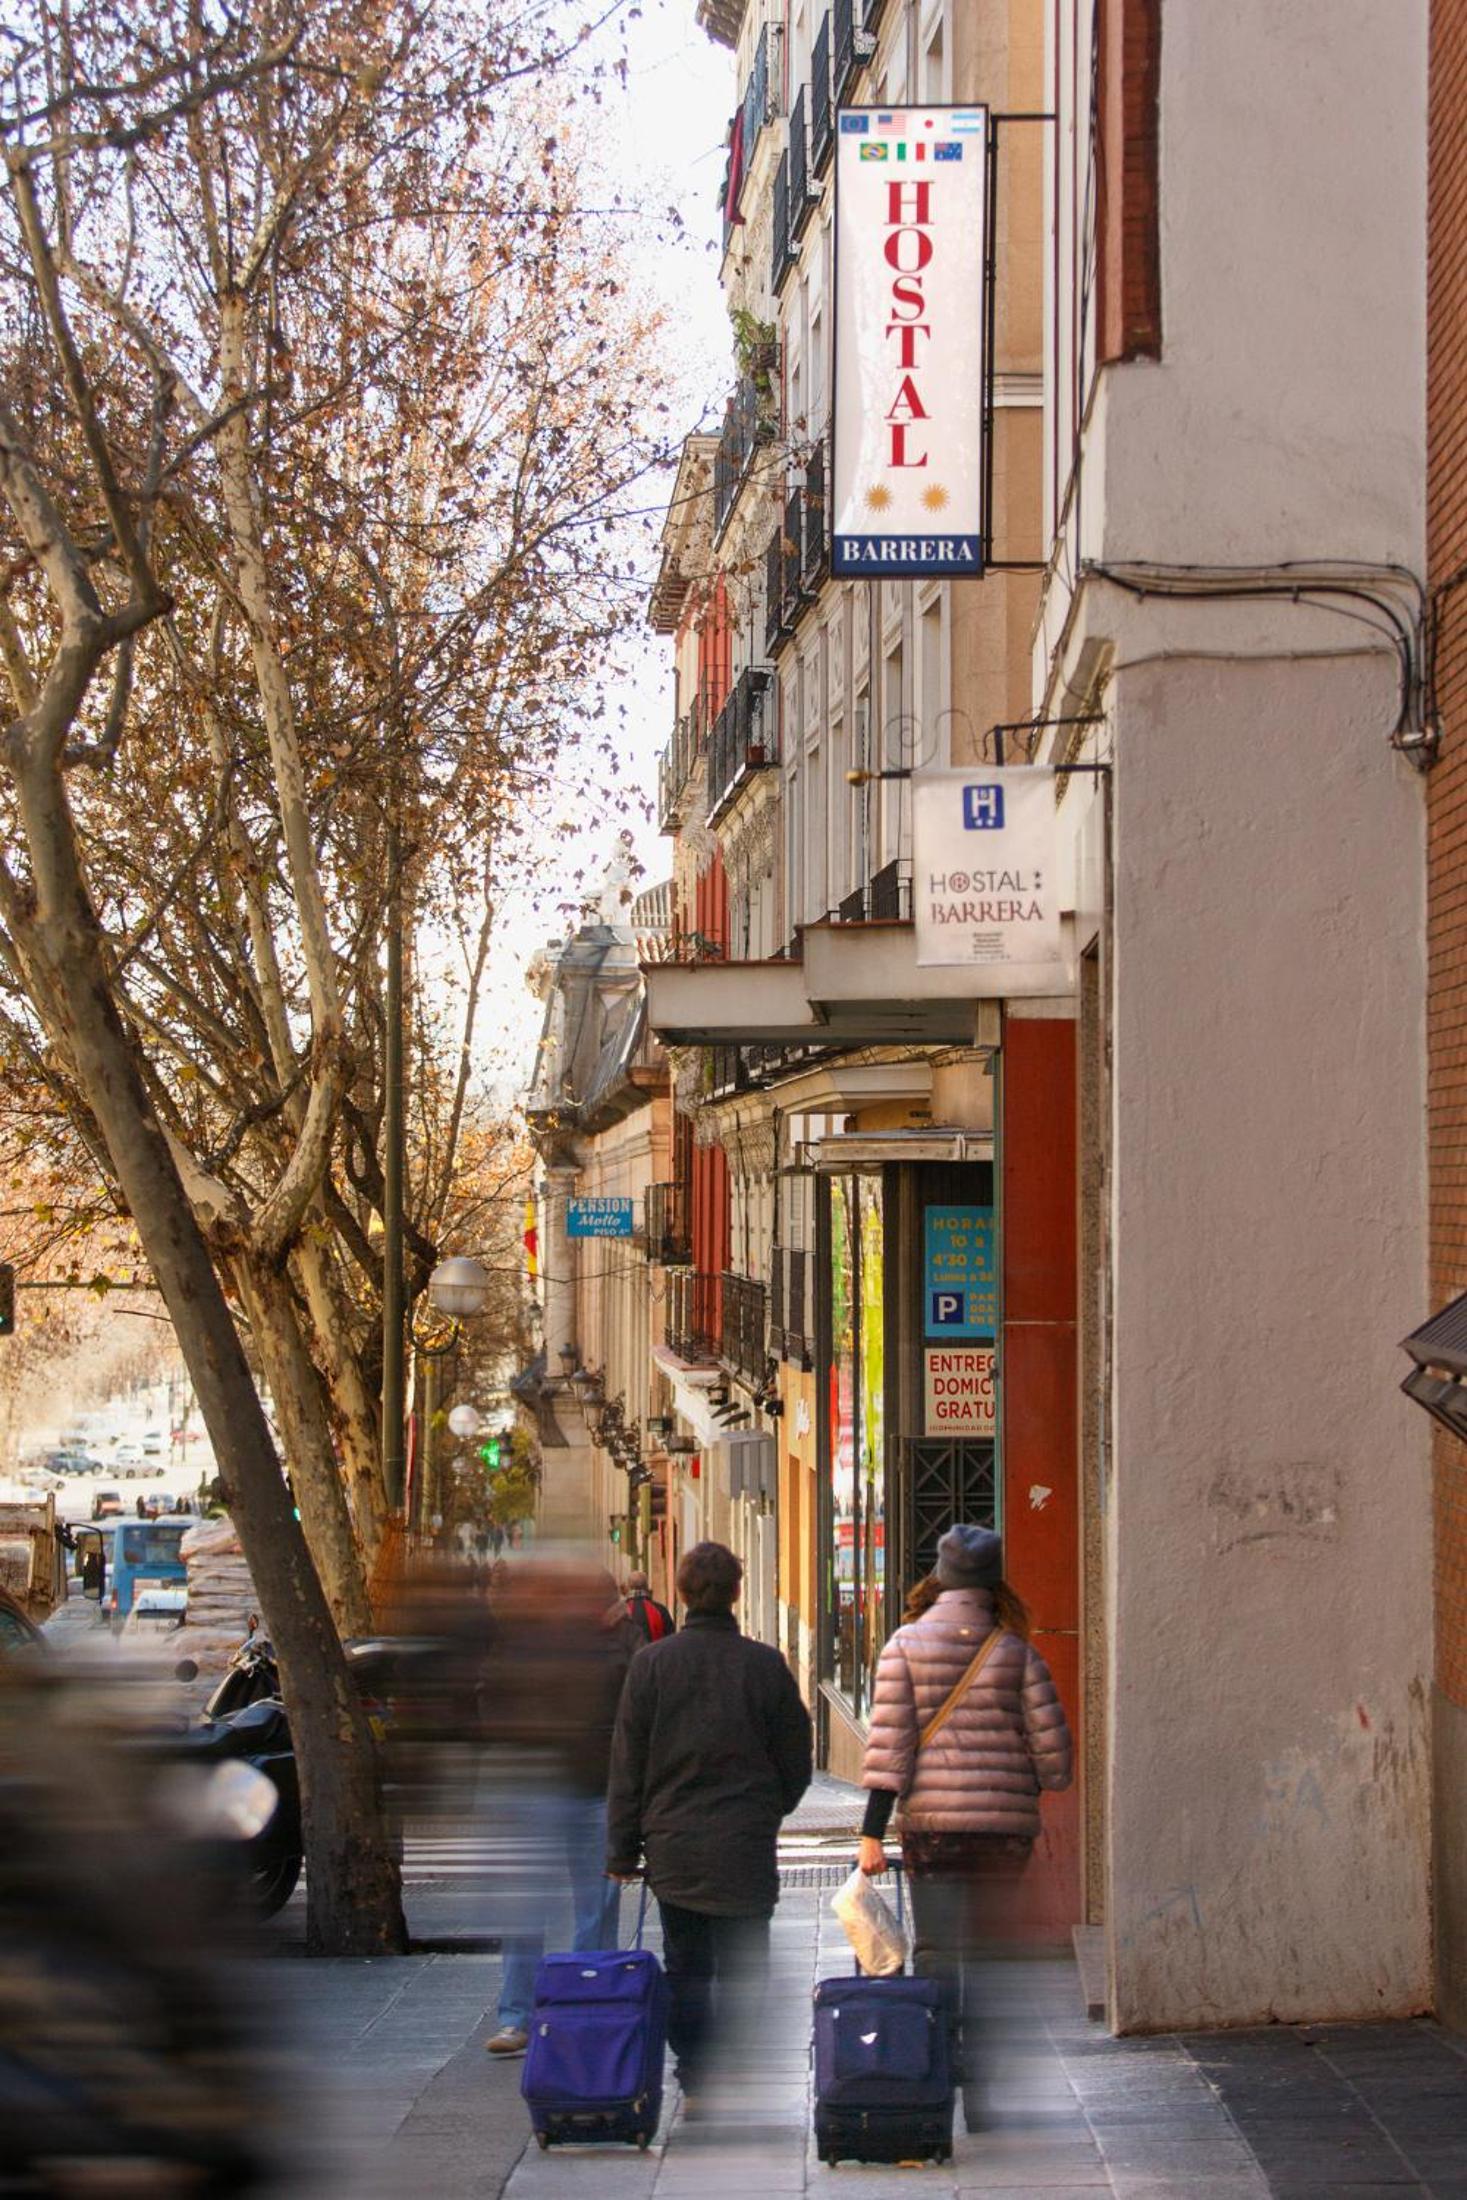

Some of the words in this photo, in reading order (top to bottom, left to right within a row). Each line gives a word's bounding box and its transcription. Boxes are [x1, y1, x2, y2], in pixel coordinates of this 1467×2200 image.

[883, 180, 935, 468] HOSTAL
[842, 539, 974, 562] BARRERA
[930, 871, 1027, 894] HOSTAL
[932, 900, 1043, 925] BARRERA
[569, 1199, 630, 1213] PENSION
[938, 1295, 958, 1322] P
[936, 1400, 995, 1420] GRATU
